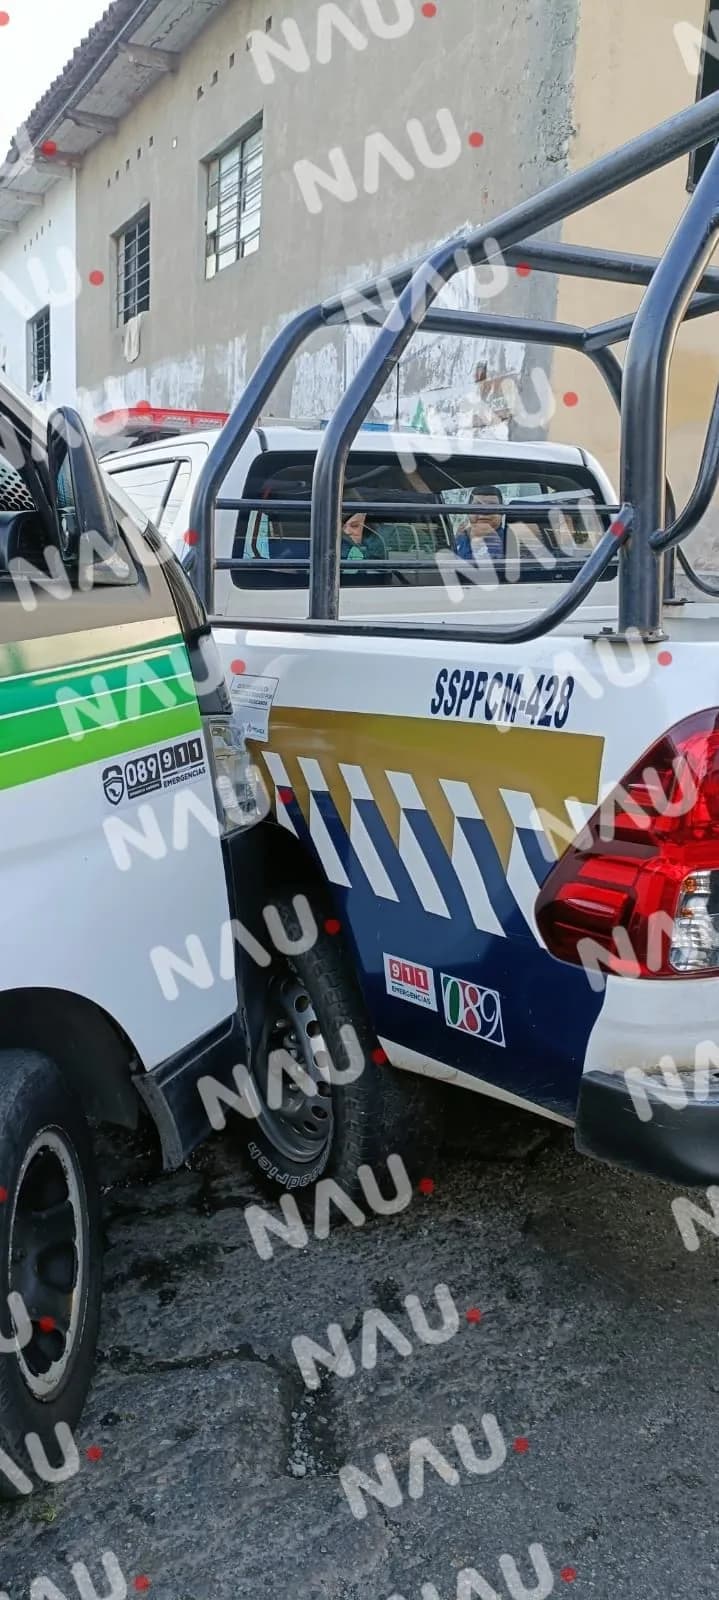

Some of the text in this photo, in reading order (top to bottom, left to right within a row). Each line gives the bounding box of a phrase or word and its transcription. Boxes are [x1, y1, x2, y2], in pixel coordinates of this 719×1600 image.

[431, 668, 574, 728] SSPPCM-428
[125, 740, 201, 788] 089 911
[163, 767, 206, 788] EMERGENCIAS
[390, 962, 427, 988] 911
[391, 985, 432, 1005] EMERGENCIAS
[444, 979, 499, 1038] 089
